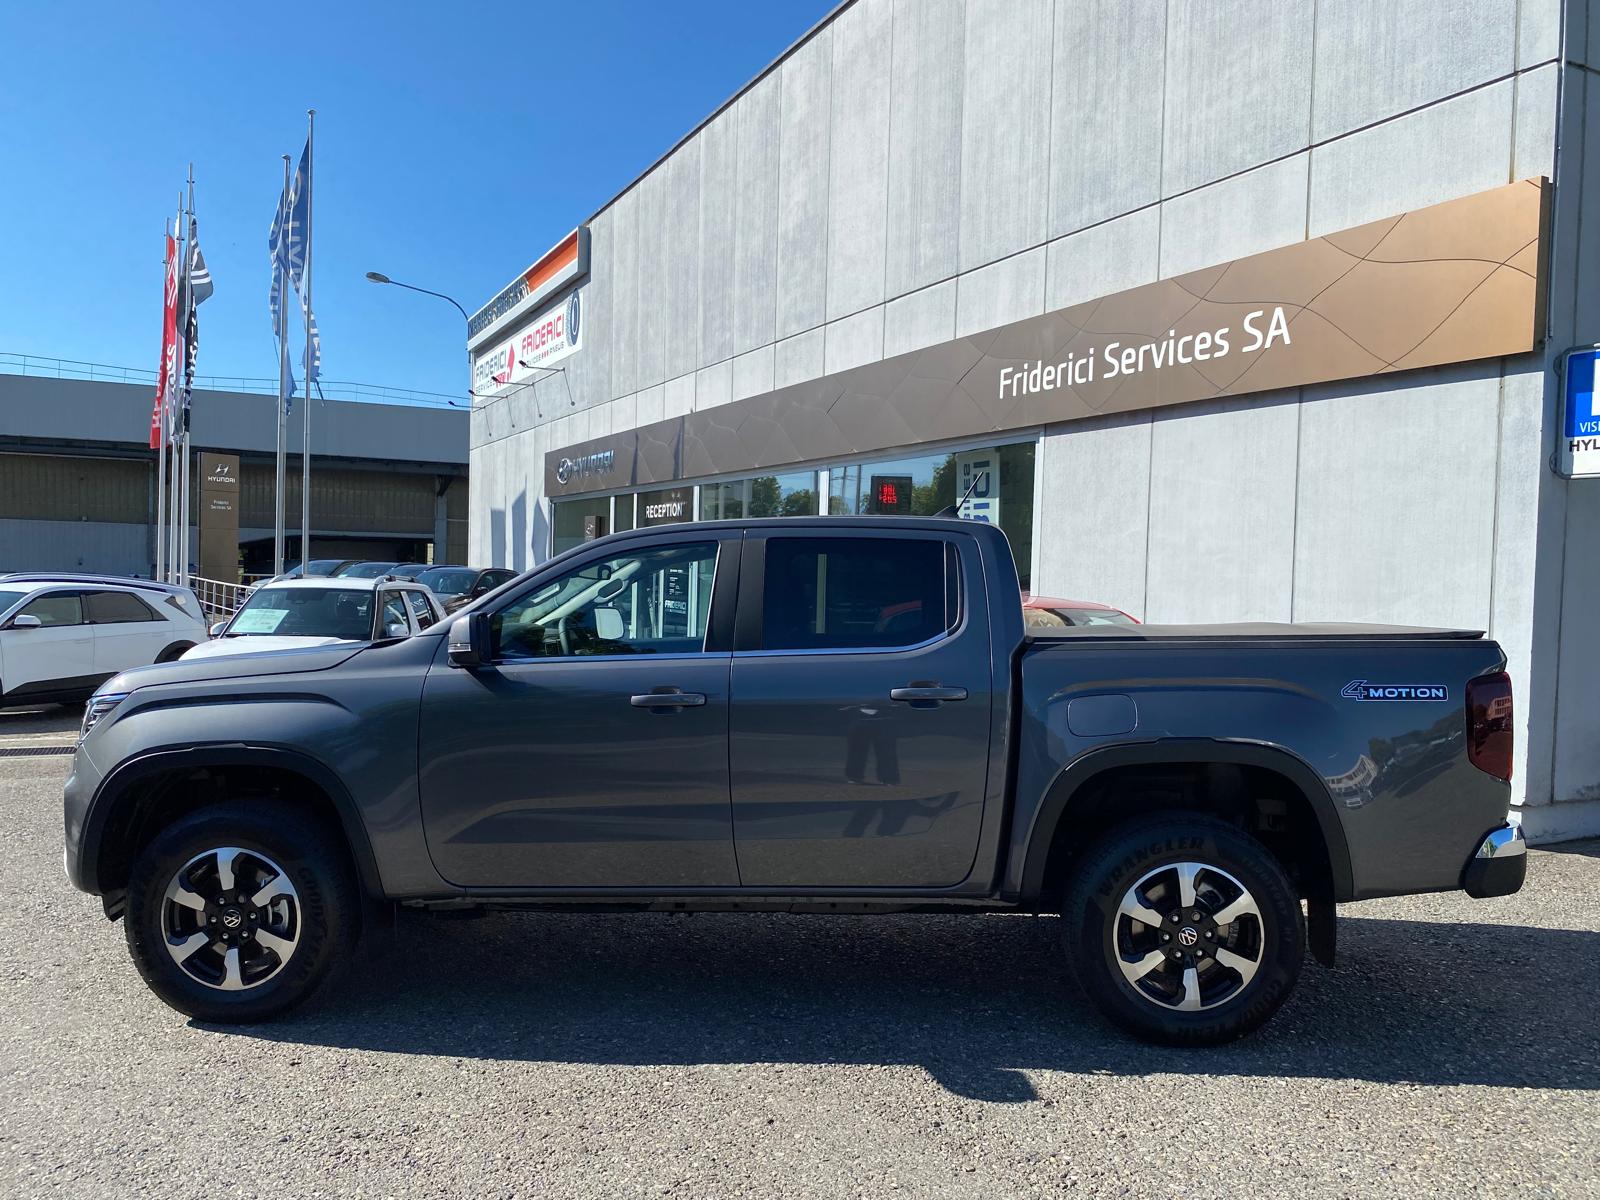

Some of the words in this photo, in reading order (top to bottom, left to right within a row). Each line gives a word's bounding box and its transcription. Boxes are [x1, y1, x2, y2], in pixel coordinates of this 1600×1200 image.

[521, 314, 565, 358] FRIDERICI
[999, 346, 1095, 400] Friderici
[1102, 326, 1231, 380] Services
[1241, 305, 1292, 354] SA
[476, 348, 507, 384] FRIDERICI
[207, 475, 236, 484] HYUNDAI
[645, 502, 684, 519] RECEPTION
